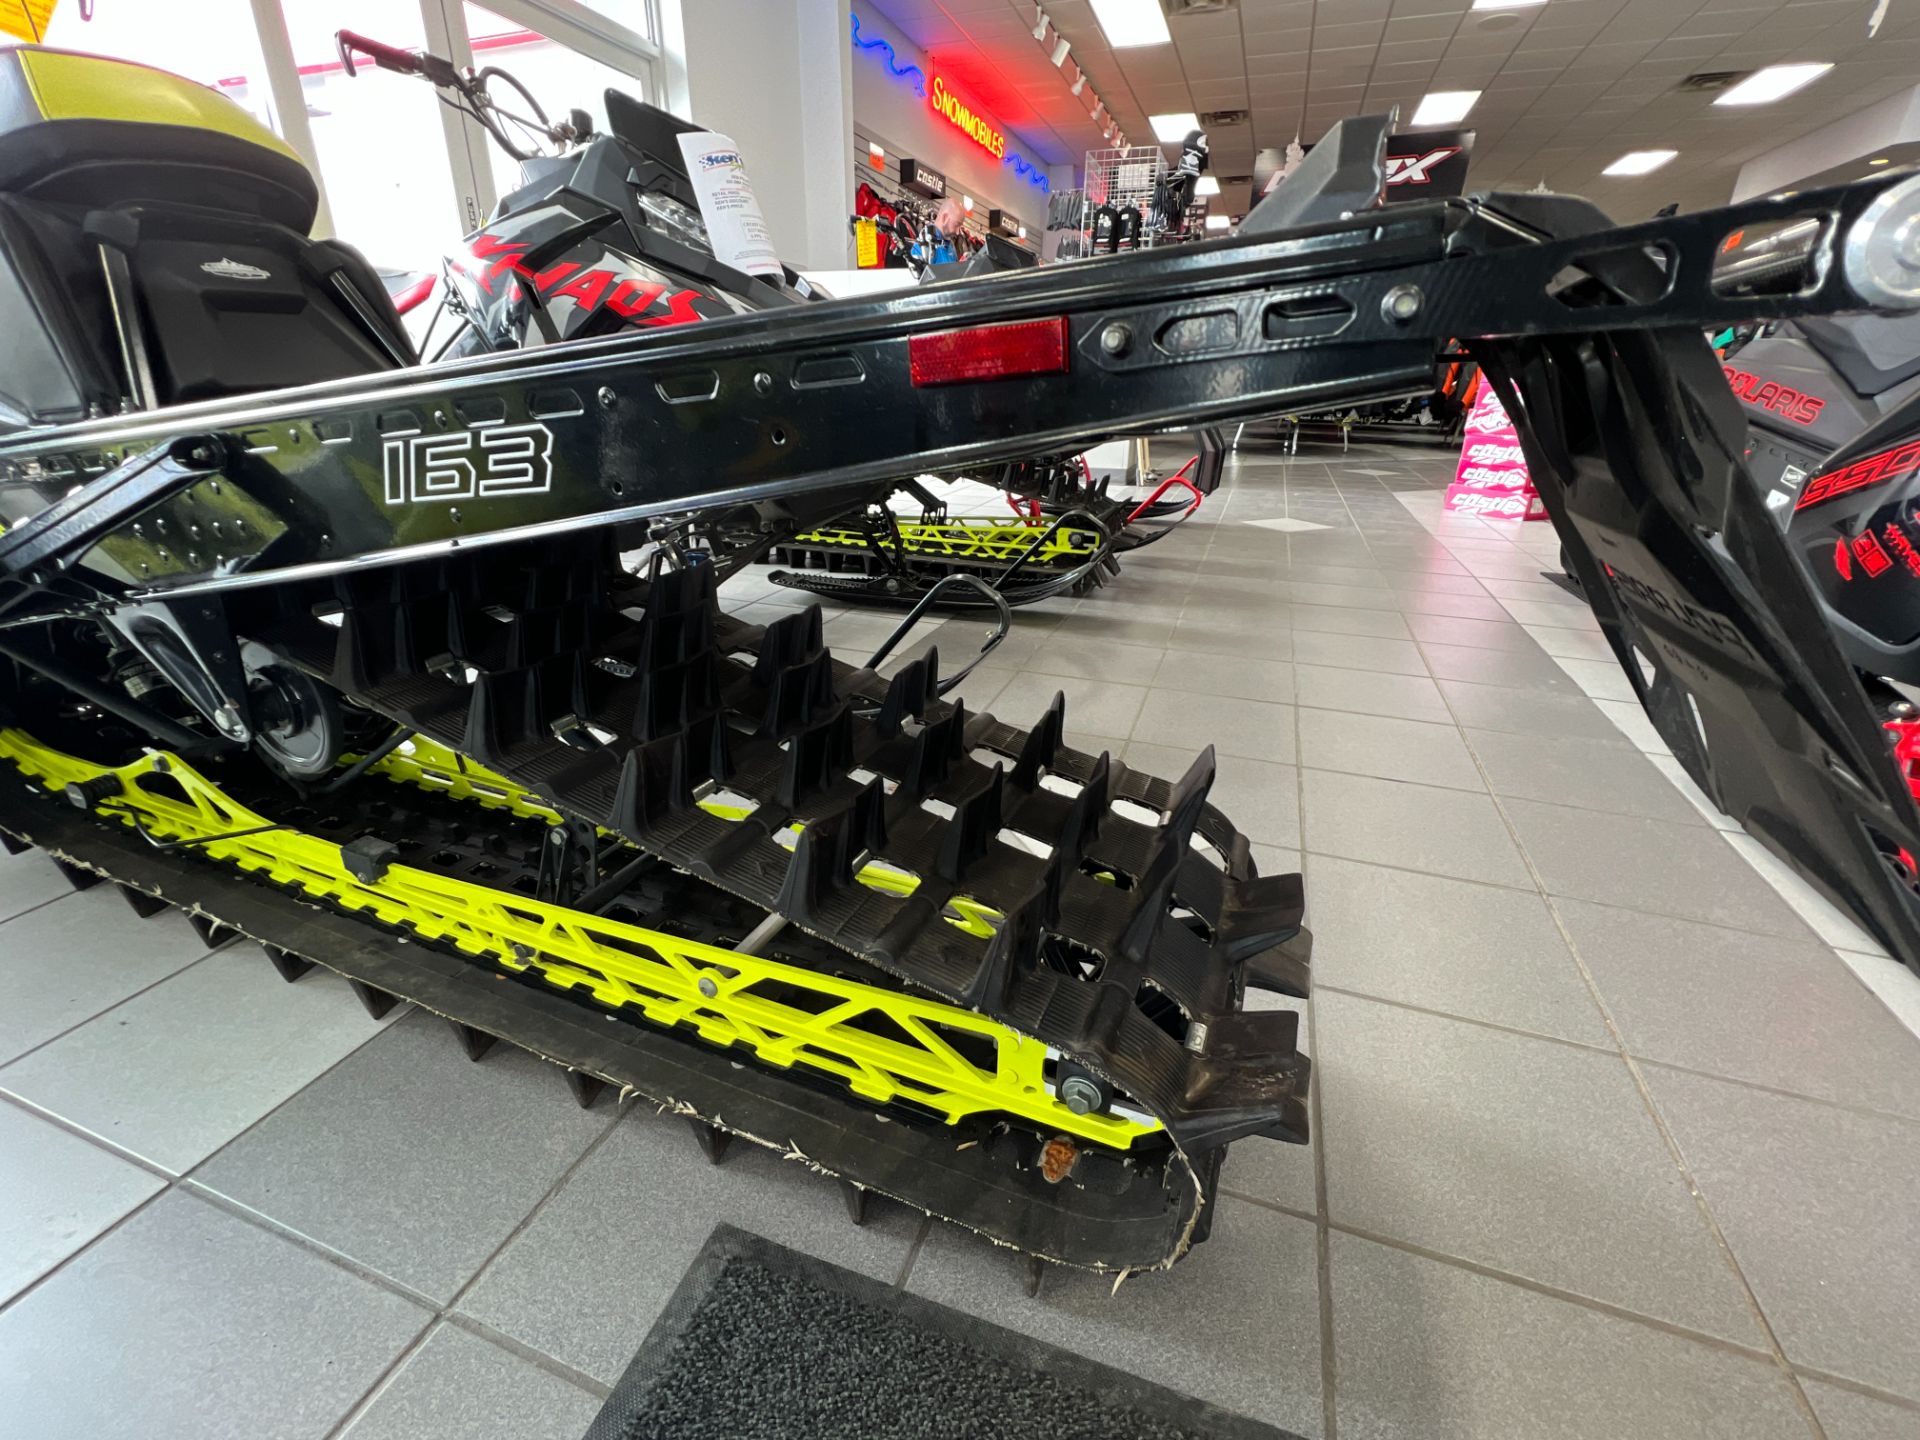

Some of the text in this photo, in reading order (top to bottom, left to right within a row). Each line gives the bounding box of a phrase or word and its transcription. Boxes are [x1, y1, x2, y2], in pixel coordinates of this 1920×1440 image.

[932, 76, 1004, 159] SNOWMOBILES
[916, 168, 943, 193] castle
[383, 422, 554, 505] 163
